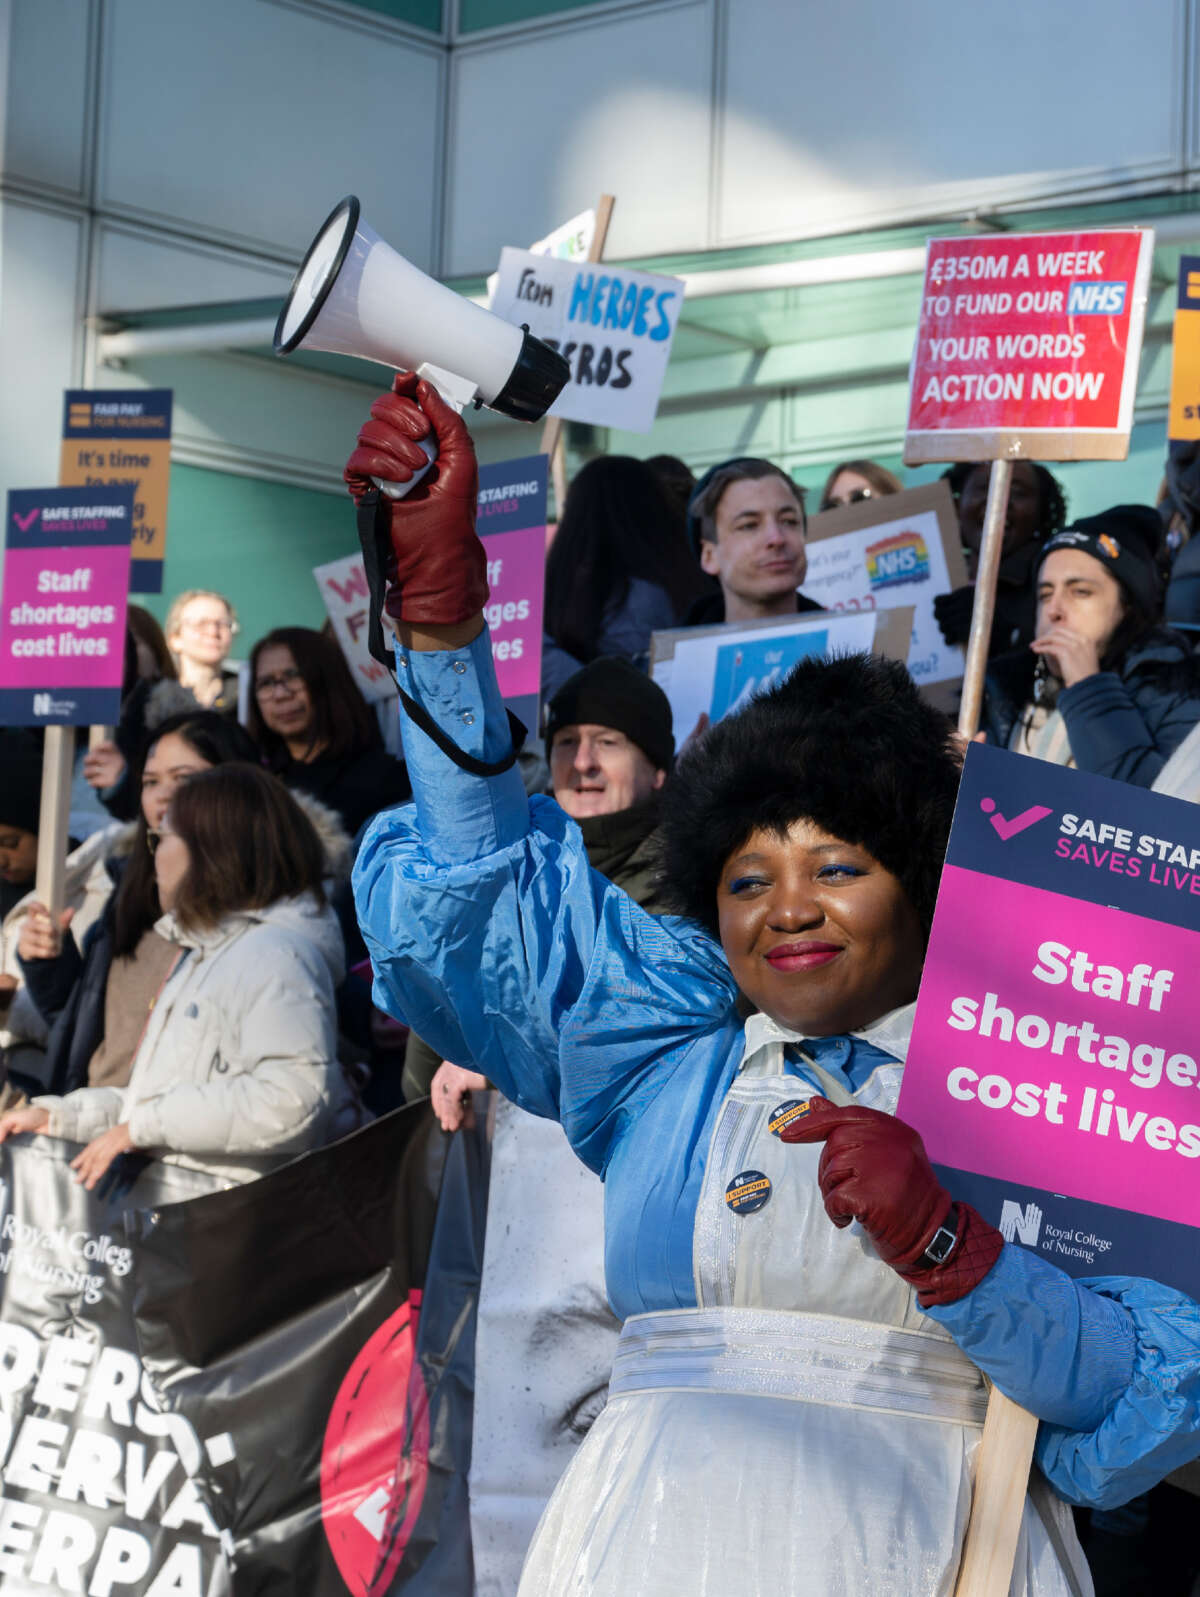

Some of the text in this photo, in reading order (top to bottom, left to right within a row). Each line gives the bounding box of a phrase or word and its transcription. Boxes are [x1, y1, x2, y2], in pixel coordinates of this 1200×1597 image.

[930, 251, 1104, 281] £350M A WEEK
[568, 272, 675, 341] HEROES
[925, 285, 1126, 317] TO FUND OUR NHS
[929, 333, 1086, 362] YOUR WORDS
[922, 372, 1104, 403] ACTION NOW
[78, 449, 150, 467] It's time
[479, 481, 538, 503] STAFFING
[878, 547, 916, 576] NHS
[37, 568, 91, 593] Staff
[10, 602, 115, 629] shortages
[11, 632, 108, 657] cost lives
[1059, 812, 1132, 852] SAFE
[1054, 837, 1142, 877] SAVES
[1031, 940, 1174, 1012] Staff
[946, 1066, 1067, 1124] cost
[2, 1214, 133, 1276] Royal Colleg
[1042, 1239, 1095, 1264] of Nursing
[1045, 1224, 1112, 1252] Royal College
